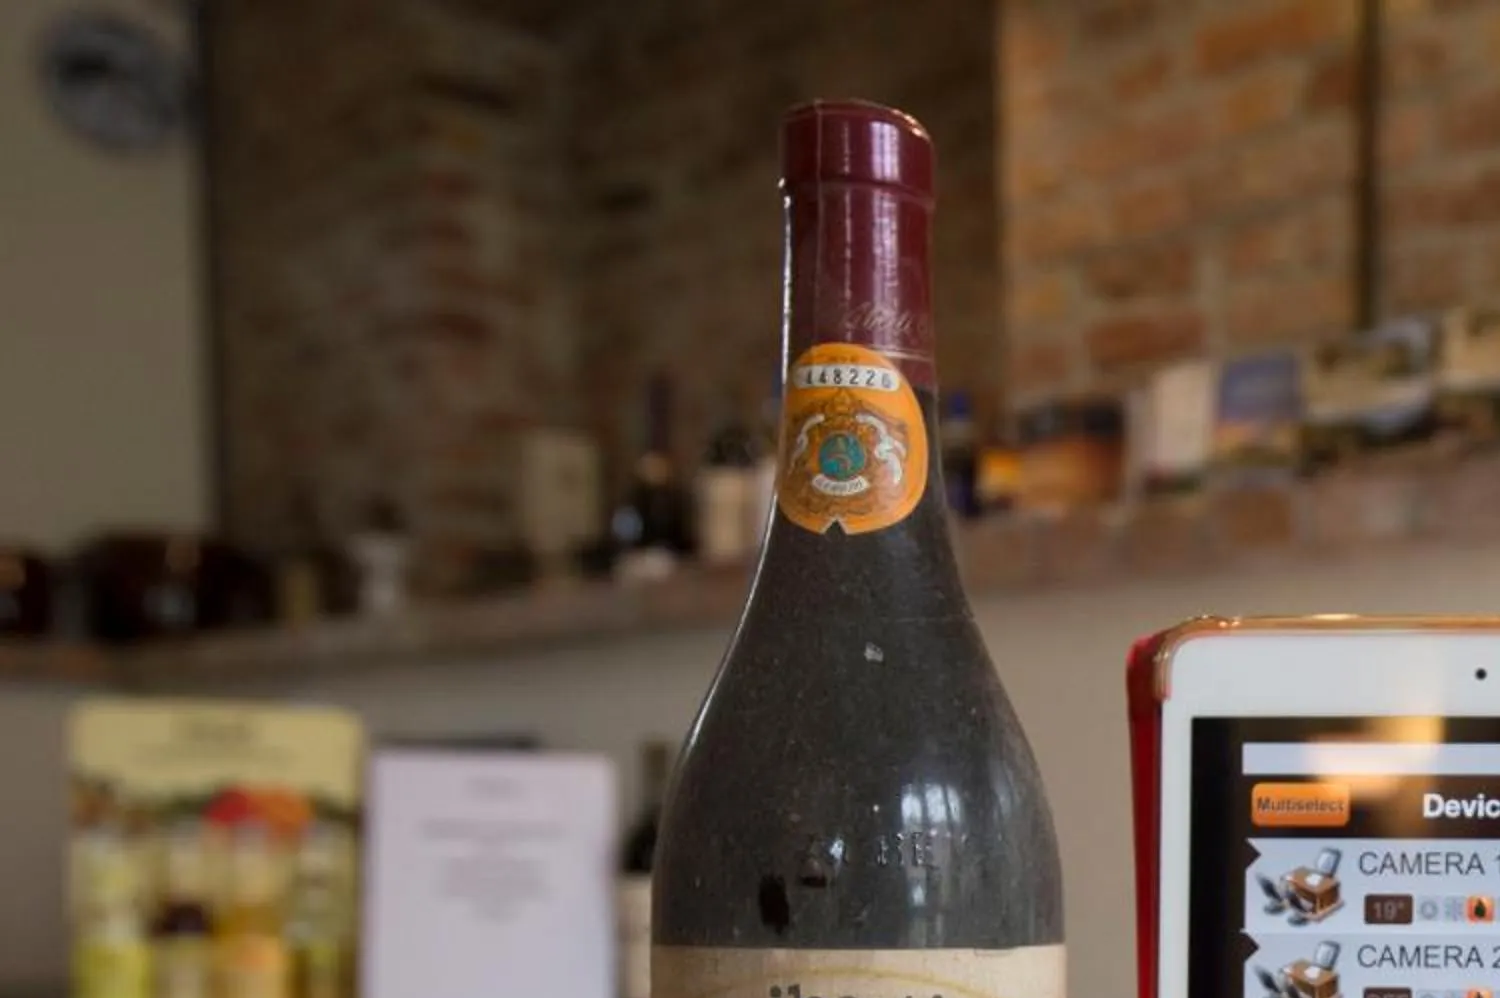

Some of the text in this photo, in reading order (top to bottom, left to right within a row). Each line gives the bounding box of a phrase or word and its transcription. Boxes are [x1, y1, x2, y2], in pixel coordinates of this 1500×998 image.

[1256, 796, 1345, 813] Multiselect
[1358, 851, 1485, 876] CAMERA
[1358, 946, 1485, 969] CAMERA
